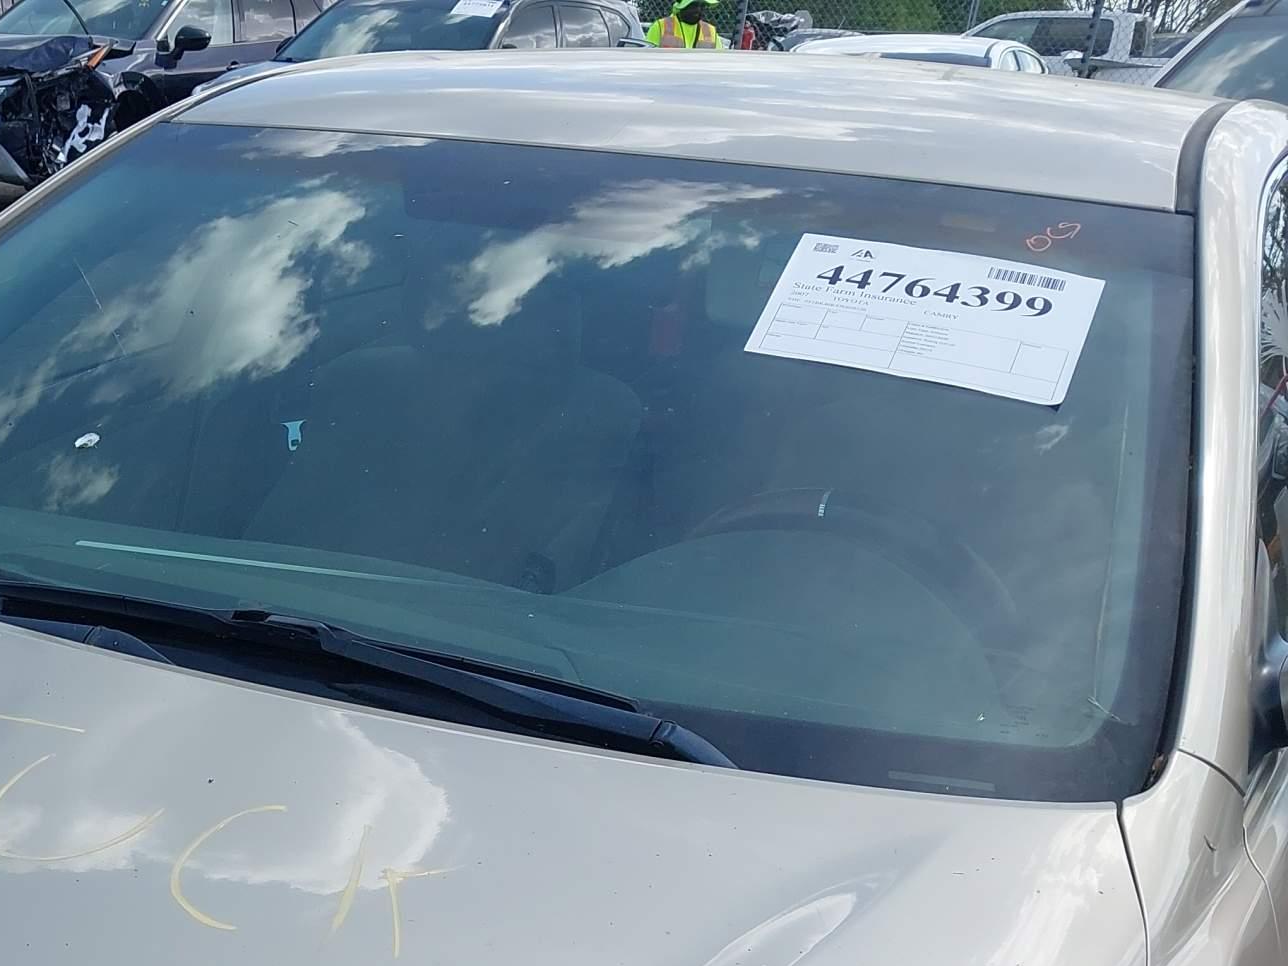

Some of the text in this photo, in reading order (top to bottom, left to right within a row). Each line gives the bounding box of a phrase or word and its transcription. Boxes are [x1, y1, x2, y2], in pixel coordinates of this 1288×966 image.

[792, 281, 823, 293] State
[825, 286, 857, 297] Farm
[859, 290, 918, 307] Insurance
[816, 264, 1054, 318] 44764399
